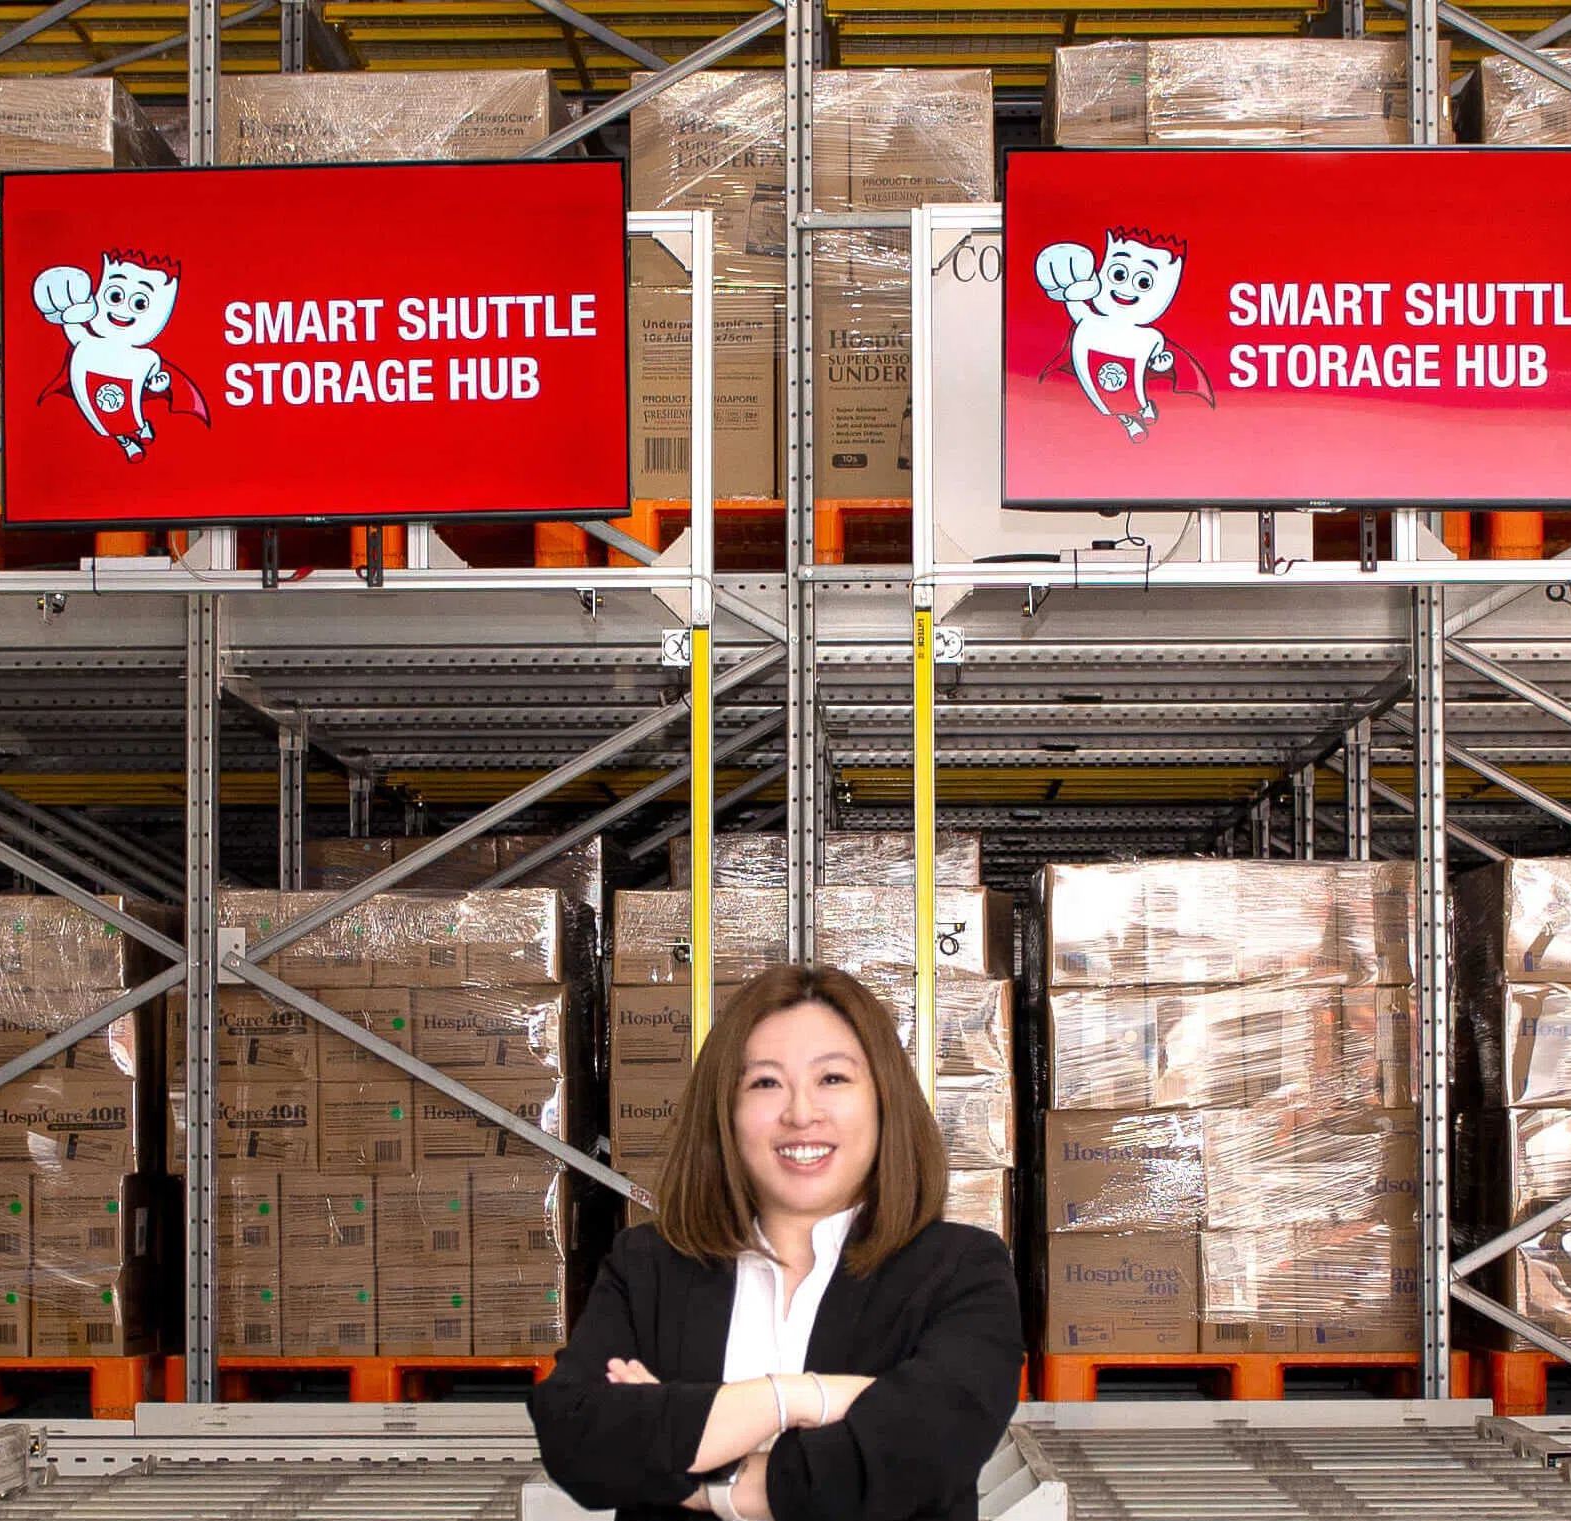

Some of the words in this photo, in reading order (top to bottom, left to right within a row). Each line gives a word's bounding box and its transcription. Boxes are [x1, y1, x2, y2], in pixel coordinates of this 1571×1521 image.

[679, 150, 787, 169] UNDERPA
[1229, 282, 1391, 326] SMART
[224, 300, 384, 345] SMART
[398, 294, 597, 341] SHUTTLE
[642, 320, 692, 333] Underpa
[666, 332, 692, 343] Adul
[829, 354, 870, 366] SUPER
[1229, 343, 1441, 388] STORAGE
[1456, 344, 1548, 387] HUB
[225, 359, 434, 406] STORAGE
[449, 356, 540, 401] HUB
[642, 395, 686, 405] PRODUCT
[86, 1106, 127, 1122] 40R
[266, 1104, 308, 1120] 40R
[1065, 1257, 1180, 1286] HospiCare
